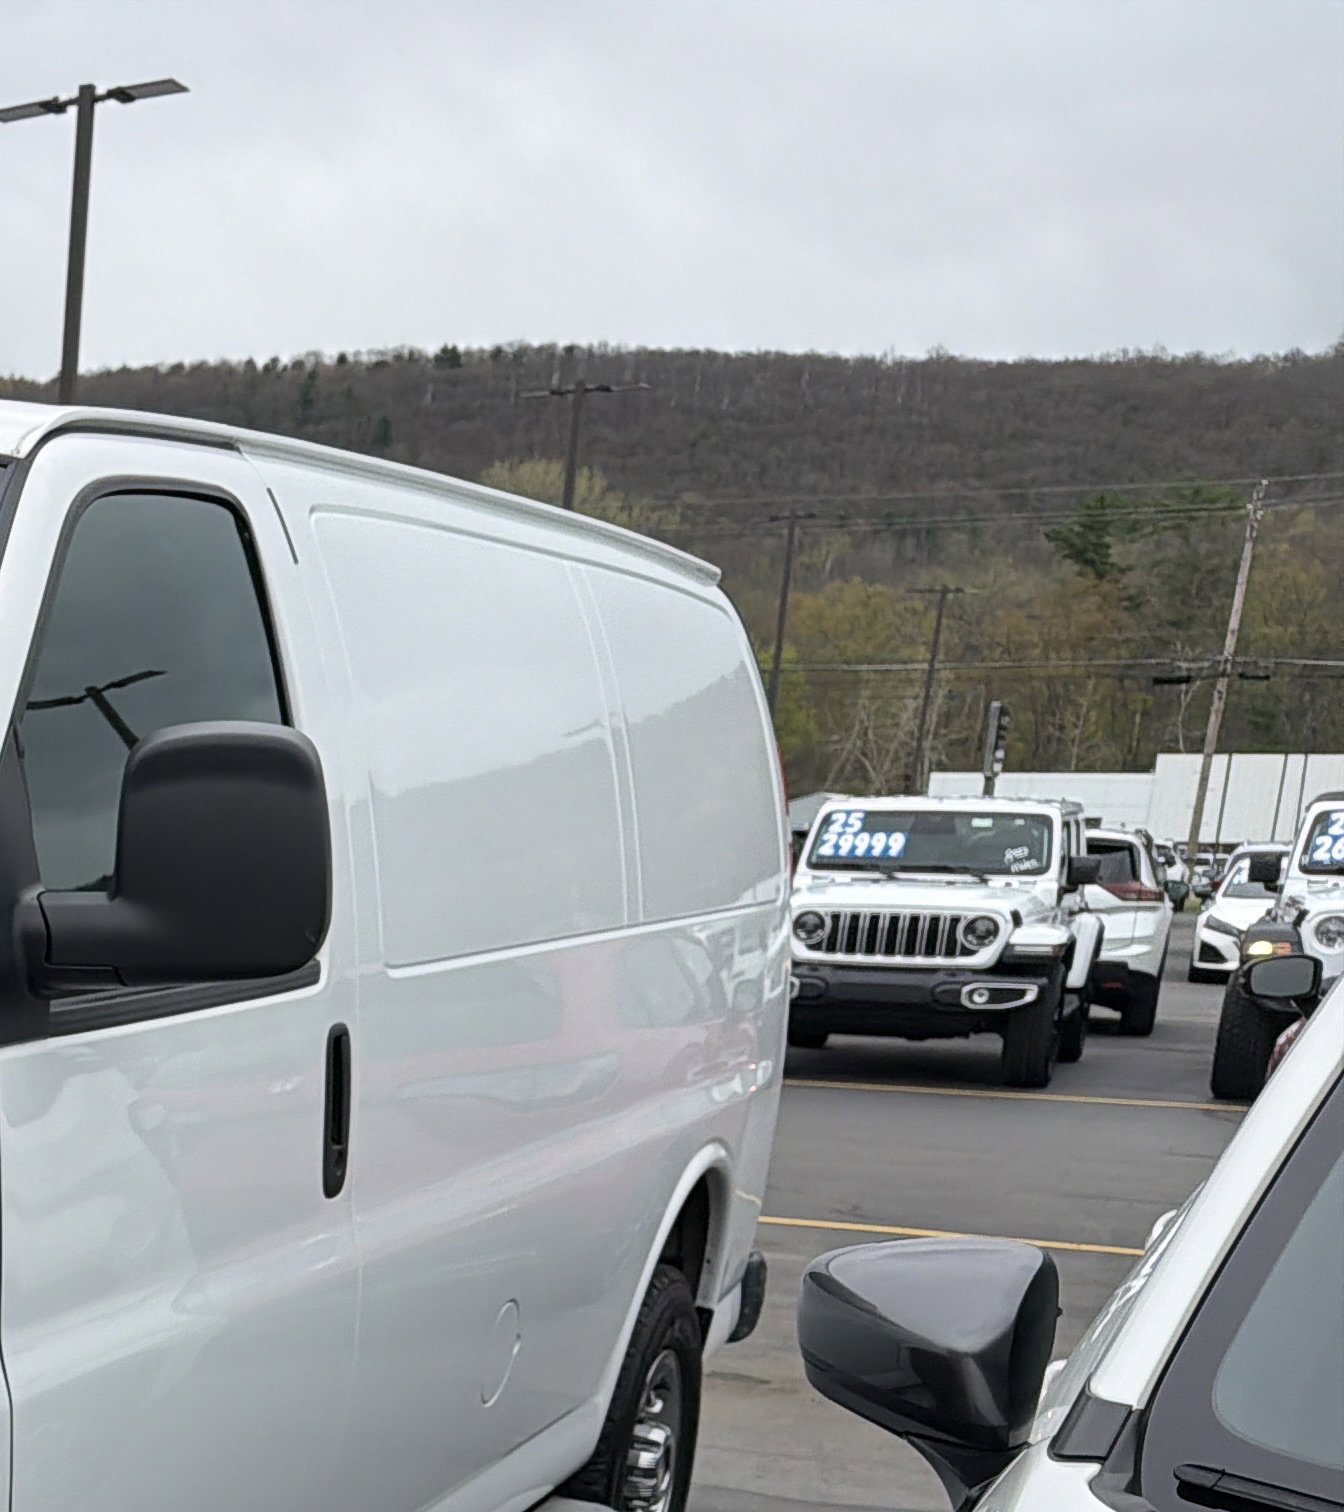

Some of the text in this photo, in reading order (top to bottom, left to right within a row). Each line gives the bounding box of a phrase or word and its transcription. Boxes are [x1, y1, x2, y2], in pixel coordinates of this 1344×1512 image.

[828, 811, 865, 834] 25
[818, 831, 906, 857] 29999
[1312, 835, 1344, 861] 26
